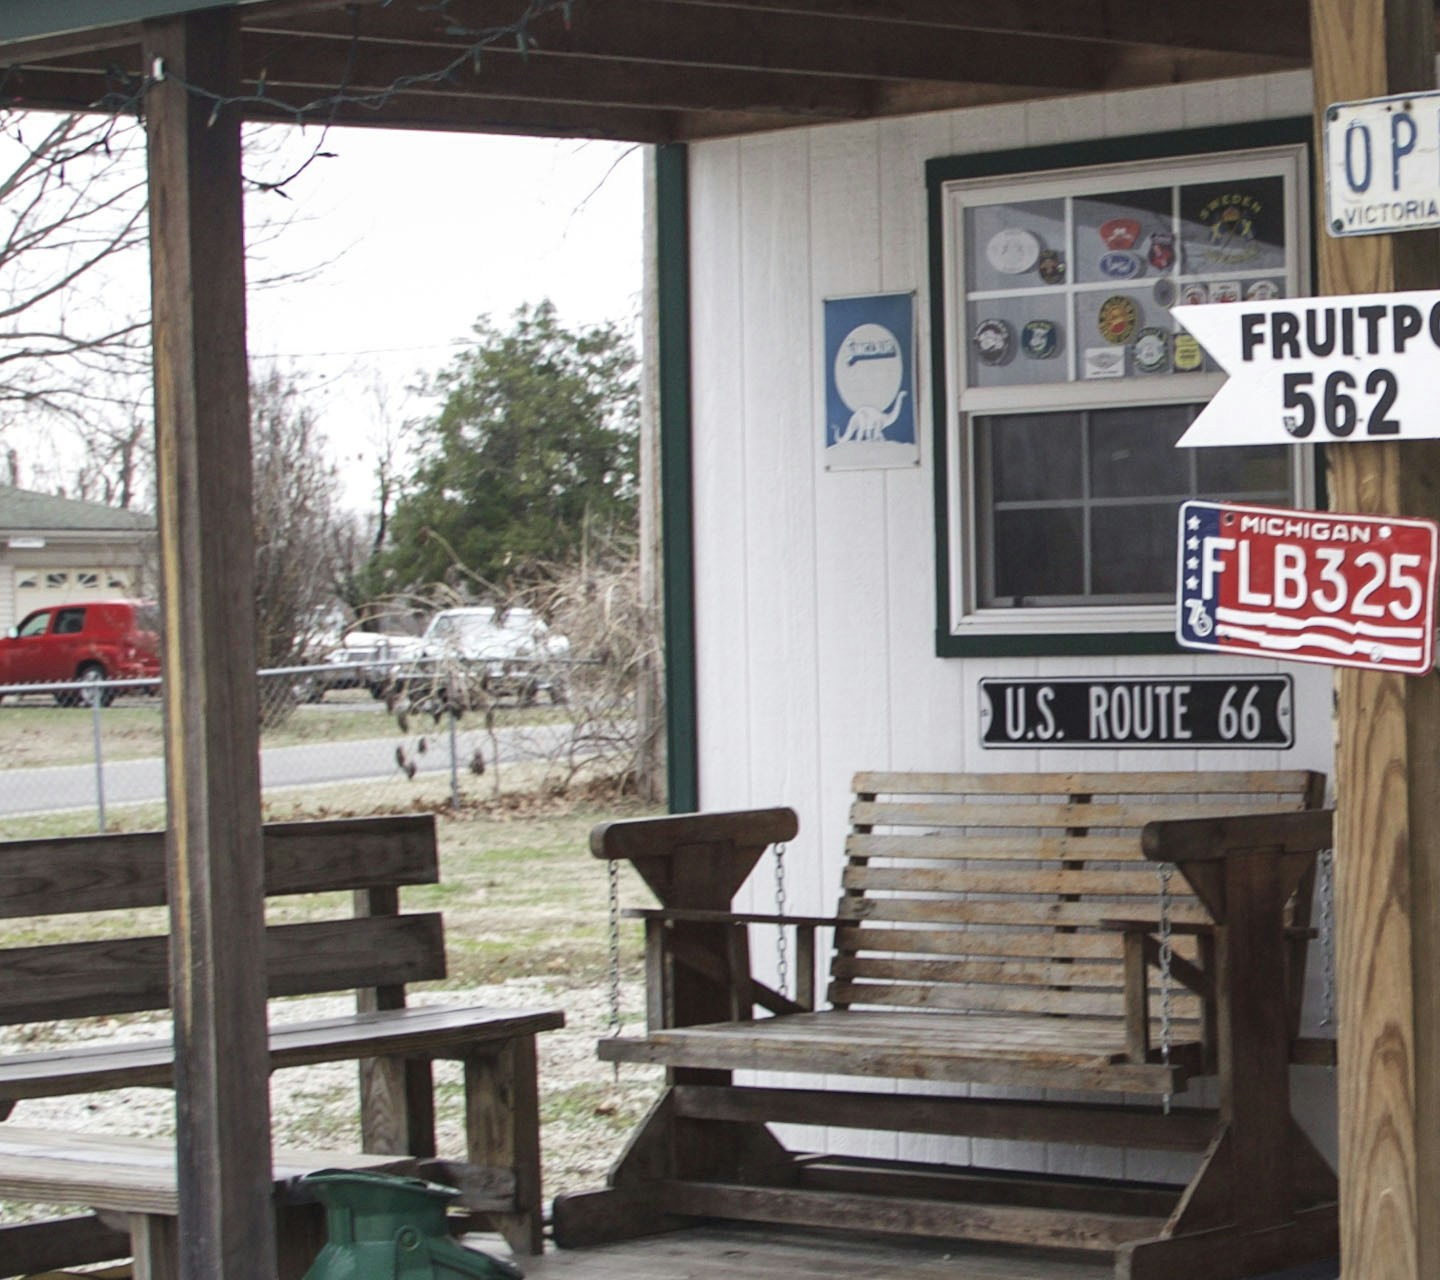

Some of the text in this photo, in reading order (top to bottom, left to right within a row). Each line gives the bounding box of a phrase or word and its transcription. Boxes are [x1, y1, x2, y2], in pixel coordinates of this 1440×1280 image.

[1282, 369, 1401, 438] 562
[1239, 515, 1371, 544] MICHIGAN
[1201, 535, 1424, 621] FLB325
[1184, 597, 1213, 637] 76
[1003, 684, 1261, 740] U.S. ROUTE 66
